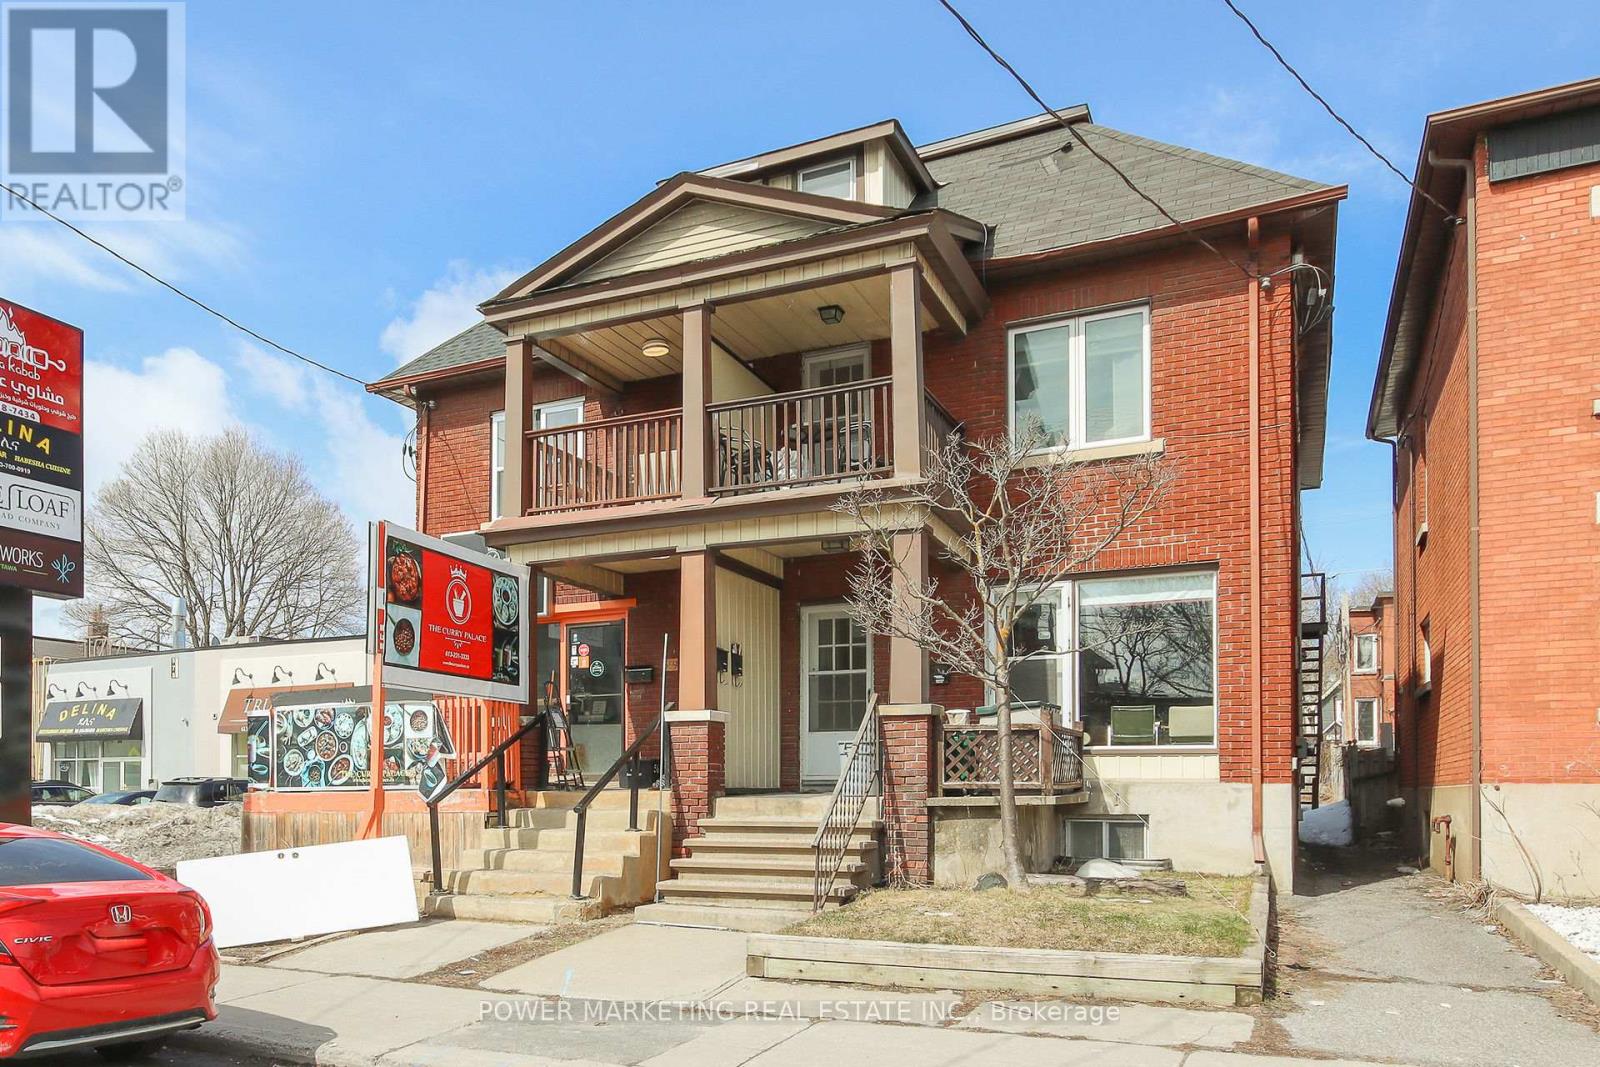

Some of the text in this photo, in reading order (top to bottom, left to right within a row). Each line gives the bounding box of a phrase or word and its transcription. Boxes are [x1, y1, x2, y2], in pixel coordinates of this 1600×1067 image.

[10, 380, 64, 406] مشاوي
[0, 419, 51, 455] INA
[17, 489, 69, 518] LOAF
[18, 514, 61, 530] COMPANY
[428, 624, 487, 643] THE CURRY PALACE
[59, 703, 116, 722] DELINA
[14, 935, 53, 944] CIVIC
